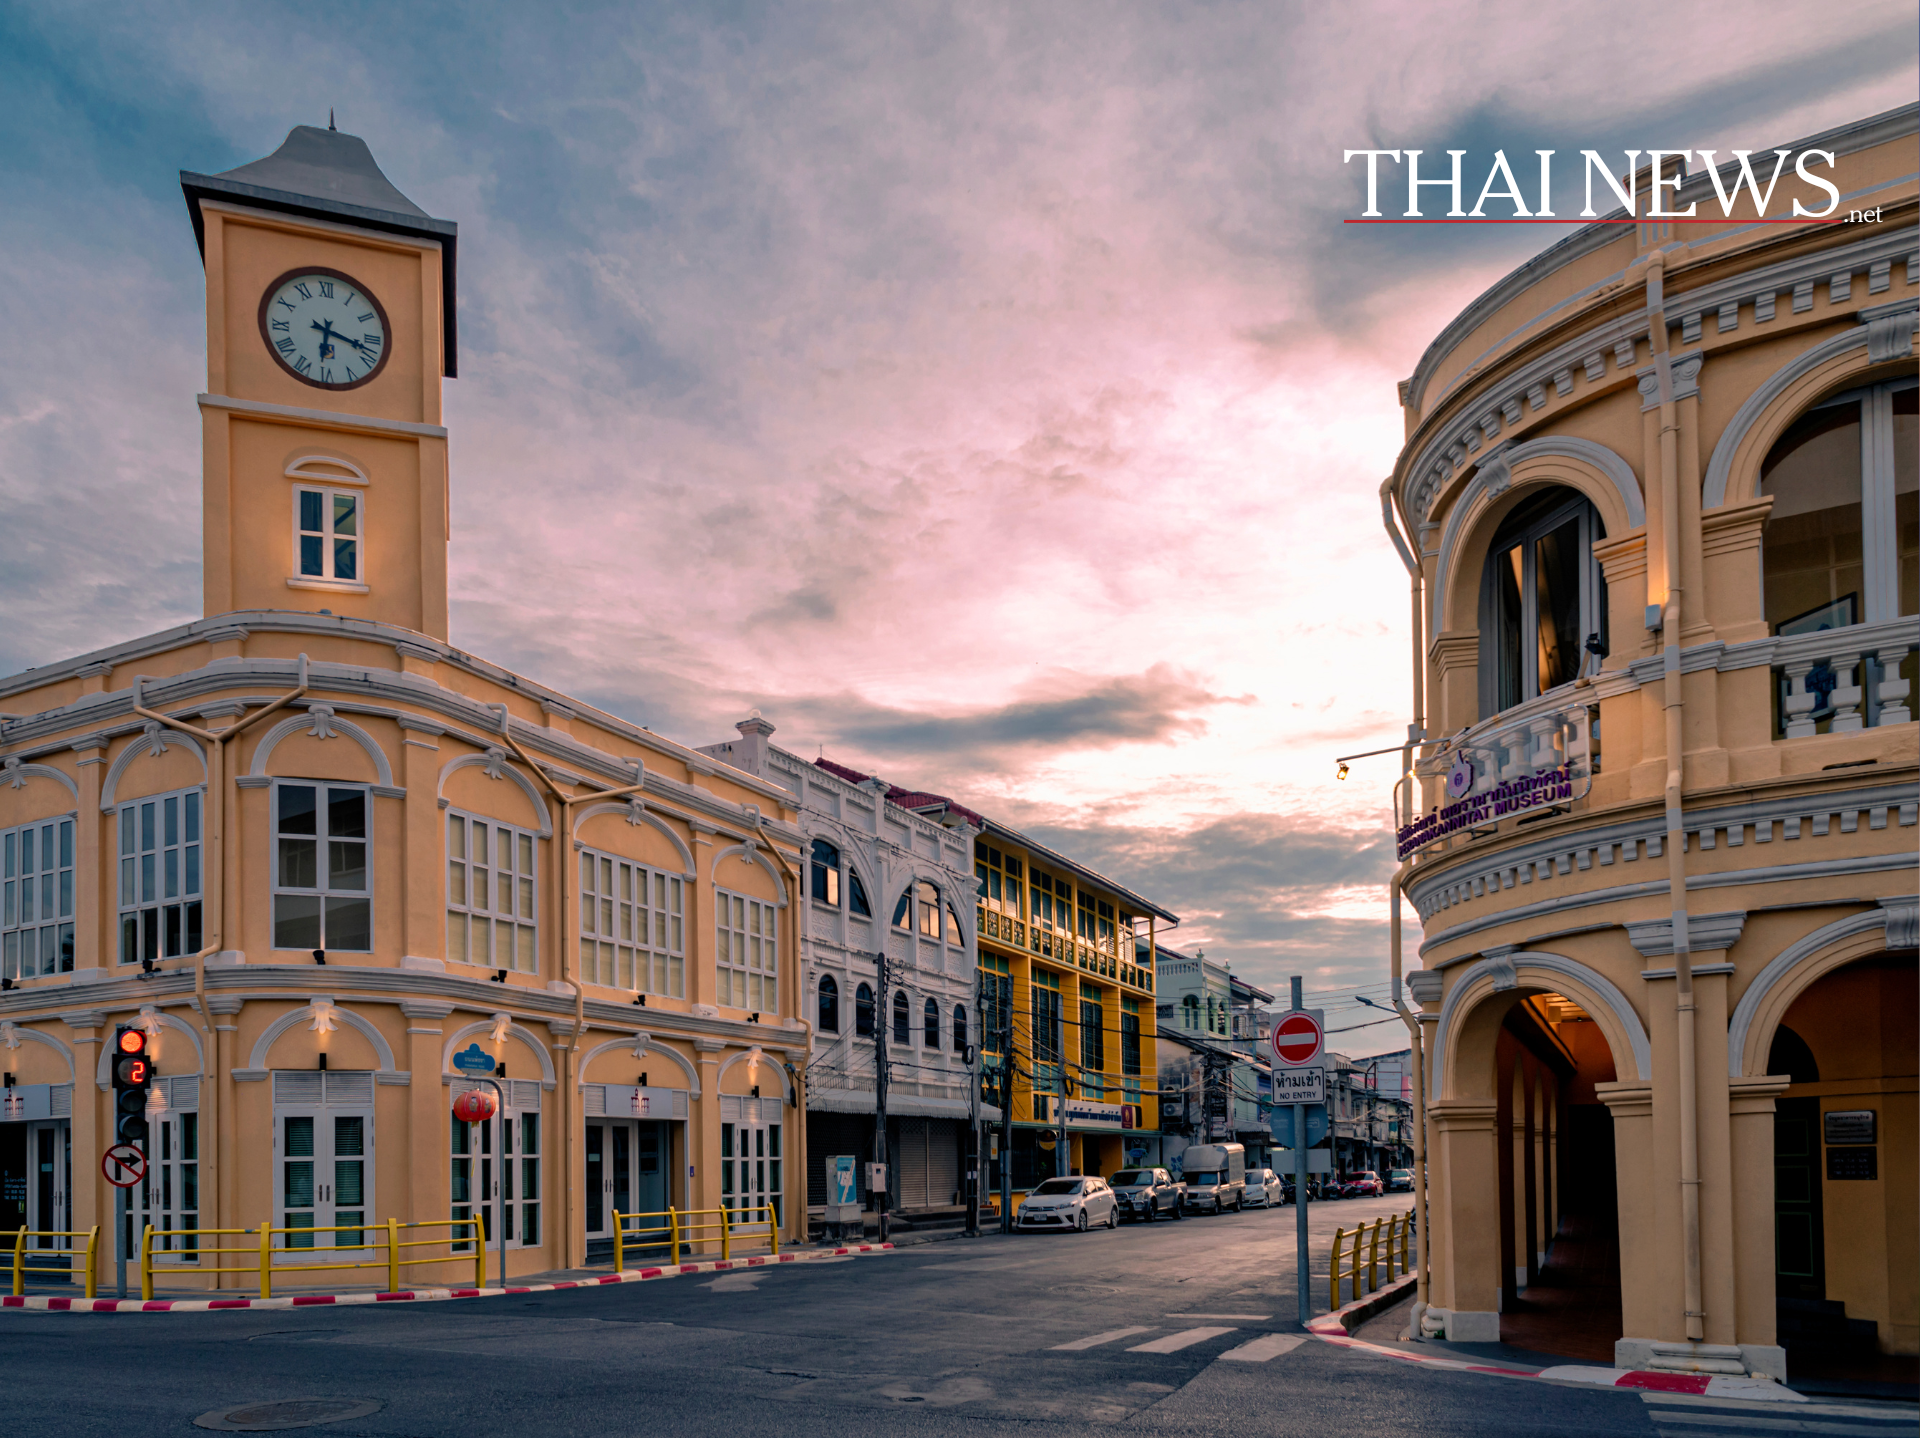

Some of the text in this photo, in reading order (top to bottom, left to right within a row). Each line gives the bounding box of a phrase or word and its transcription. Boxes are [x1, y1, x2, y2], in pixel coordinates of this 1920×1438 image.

[293, 282, 313, 301] XI
[318, 281, 334, 299] XII
[277, 296, 296, 313] X
[272, 318, 289, 332] IX
[357, 312, 375, 323] II
[364, 333, 381, 346] III
[320, 366, 334, 383] VI
[1398, 783, 1572, 857] PERANAKANNITAT MUSEUM
[131, 1061, 145, 1083] 2
[1276, 1070, 1321, 1088] ห้ามเข้า
[1279, 1091, 1317, 1100] NO ENTRY
